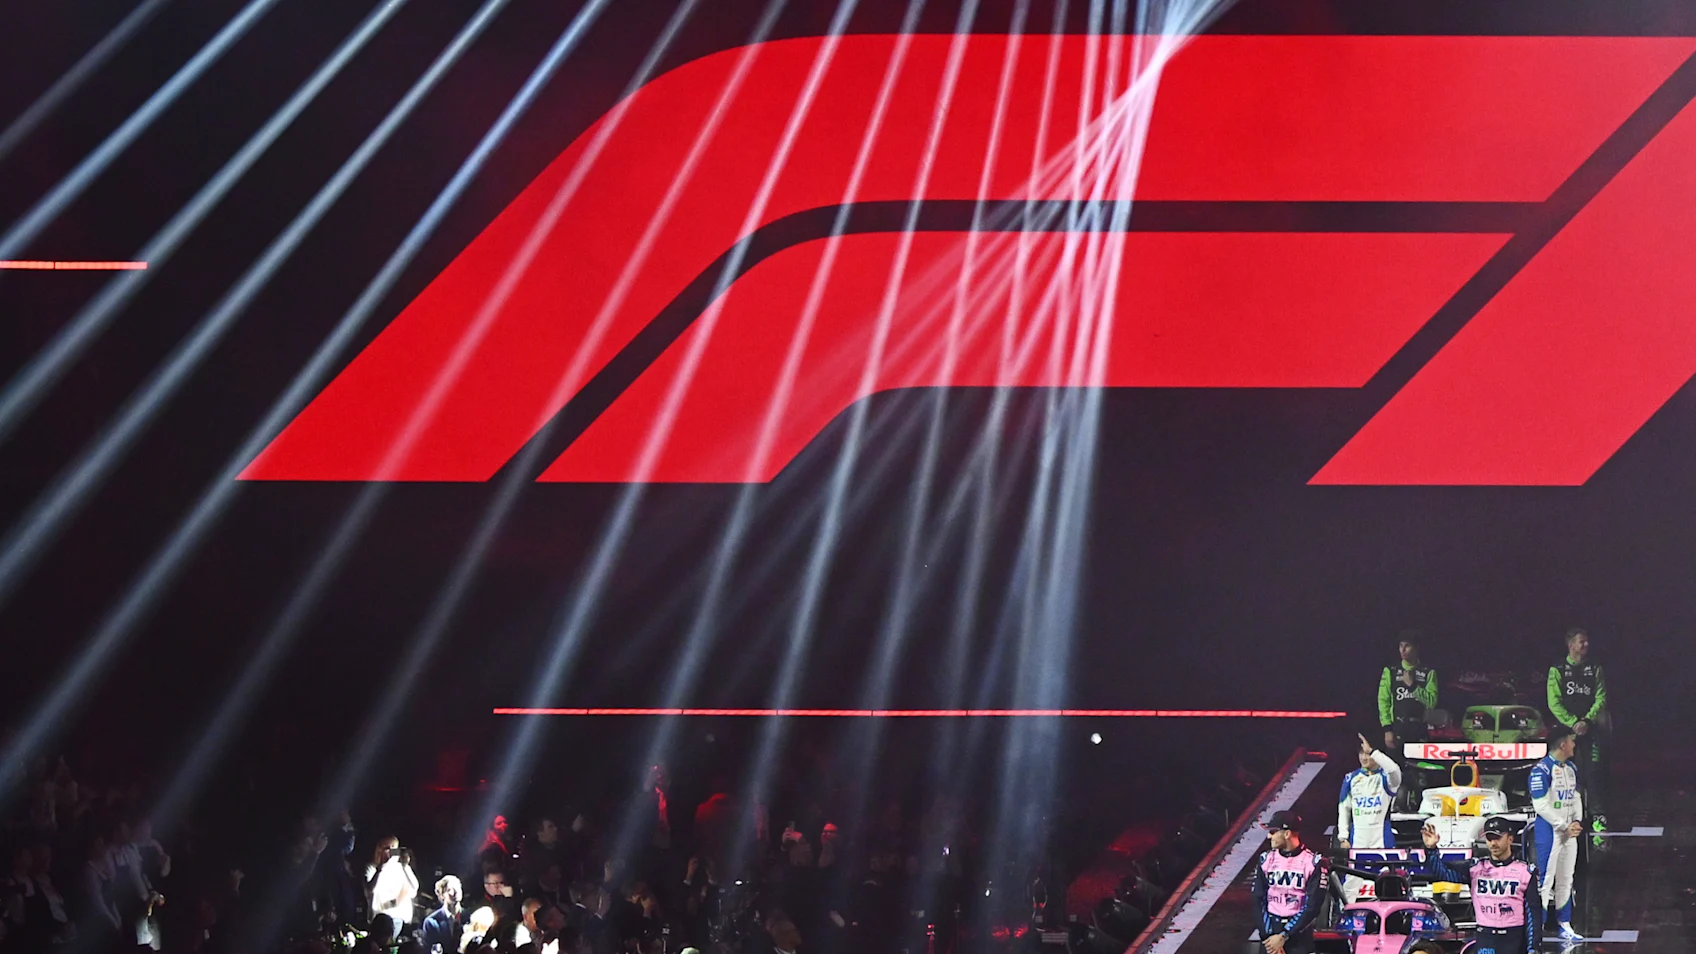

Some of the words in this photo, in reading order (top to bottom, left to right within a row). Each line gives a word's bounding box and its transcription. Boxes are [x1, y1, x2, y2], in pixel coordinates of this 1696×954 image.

[1396, 687, 1417, 701] Sta
[1480, 743, 1527, 759] Bull
[1354, 796, 1382, 808] VISA
[1556, 789, 1575, 801] VIS
[1267, 870, 1305, 888] BWT
[1476, 878, 1520, 896] BWT
[1480, 903, 1497, 914] eni
